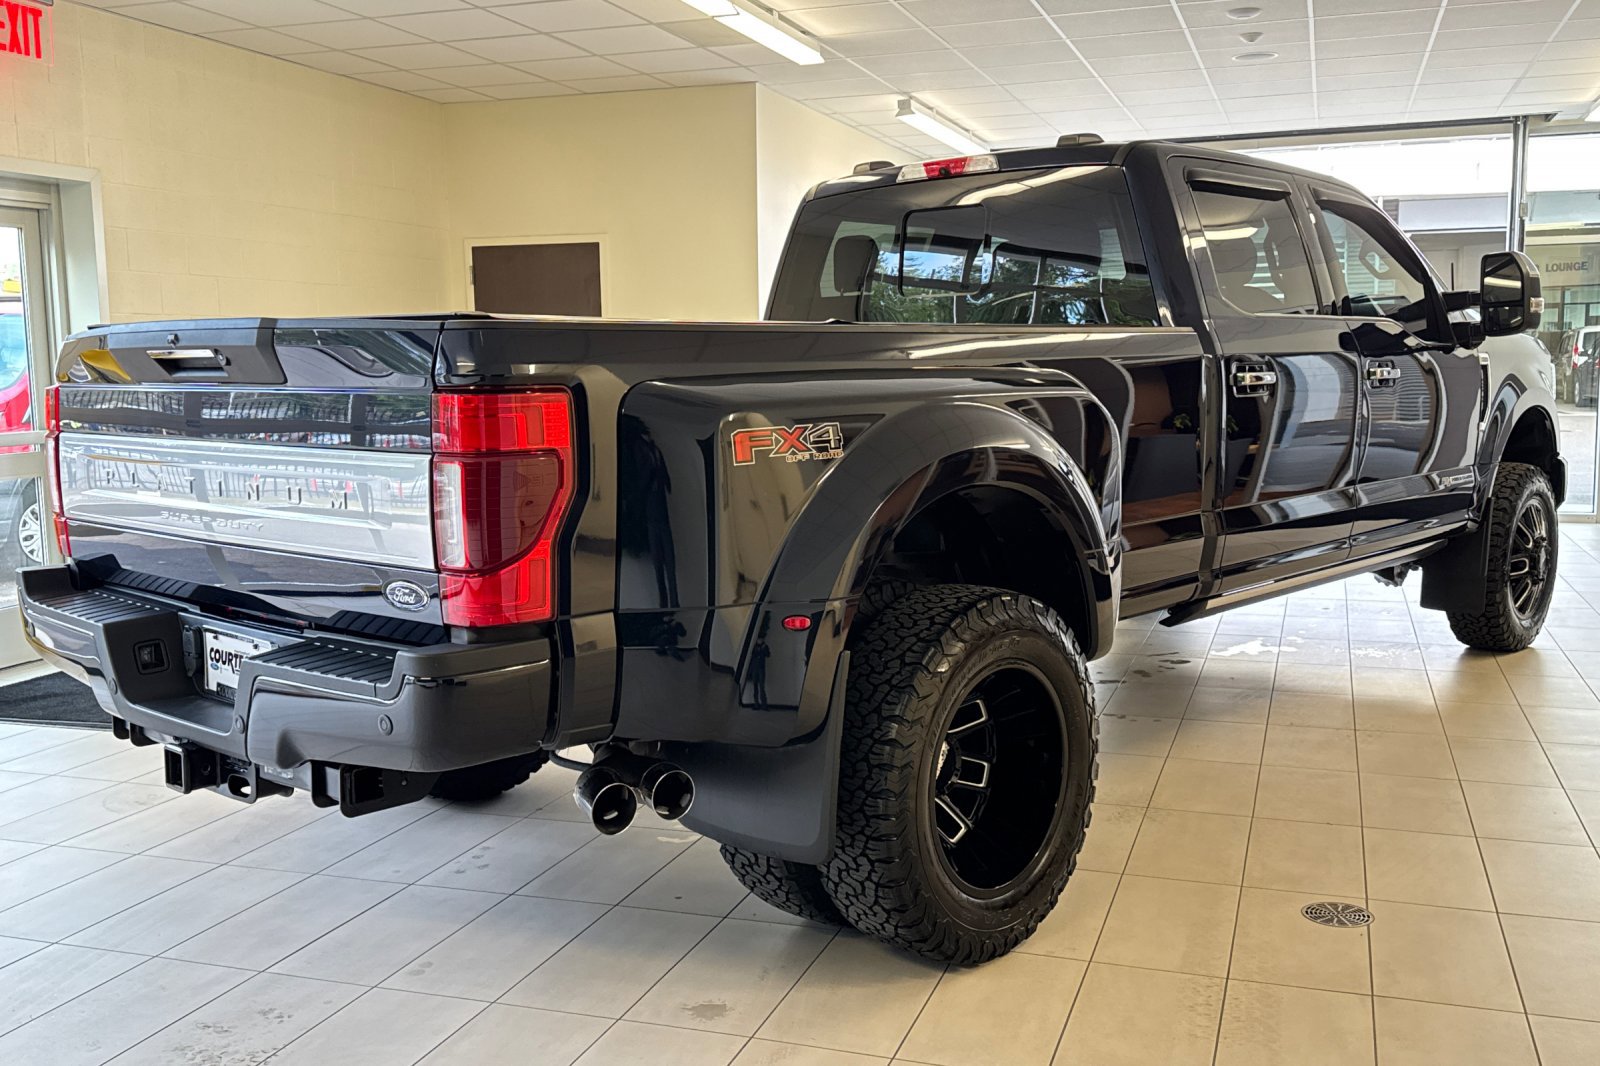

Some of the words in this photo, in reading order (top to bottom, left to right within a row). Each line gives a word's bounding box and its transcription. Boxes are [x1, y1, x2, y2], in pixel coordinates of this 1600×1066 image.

[1545, 261, 1588, 272] LOUNGE
[731, 422, 842, 466] FX4
[786, 453, 809, 462] OFF
[813, 450, 844, 460] ROAD
[104, 468, 349, 510] PLATINUM
[160, 510, 212, 524] SUPER
[215, 518, 264, 532] DUTY
[393, 587, 416, 604] Ford
